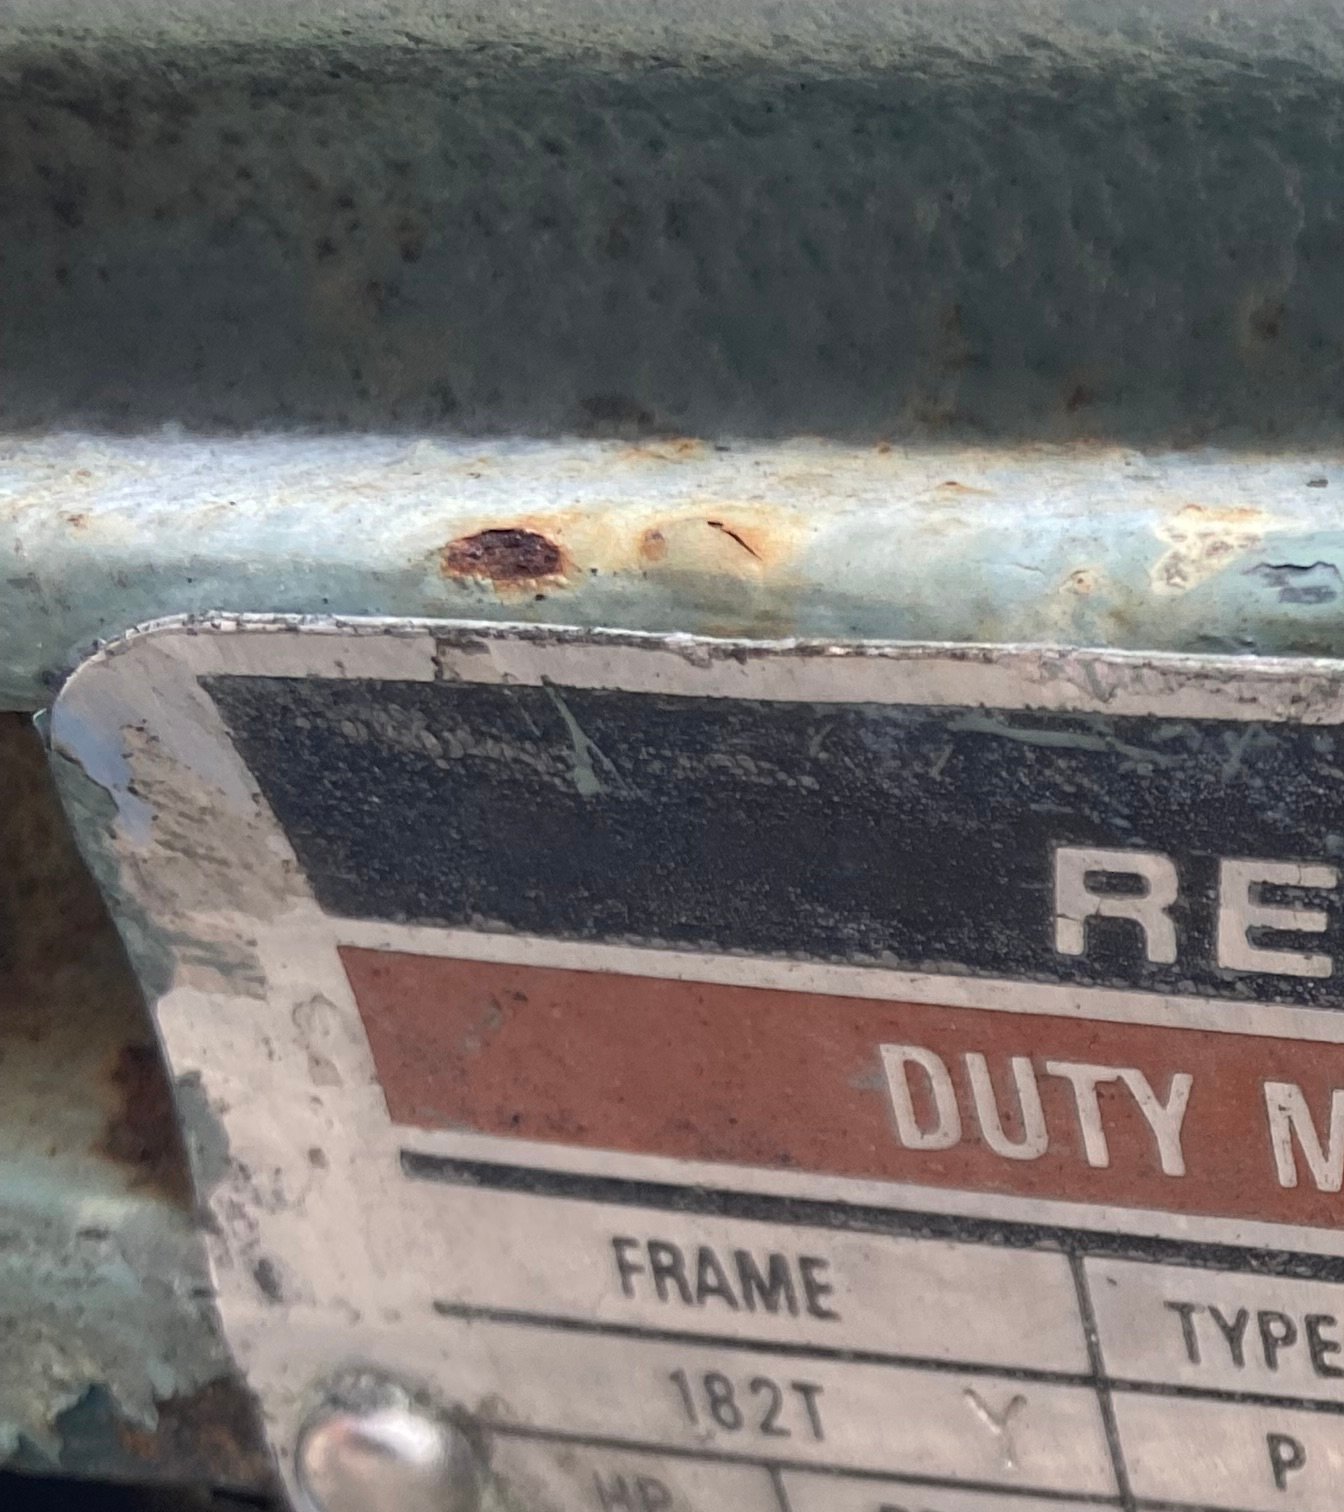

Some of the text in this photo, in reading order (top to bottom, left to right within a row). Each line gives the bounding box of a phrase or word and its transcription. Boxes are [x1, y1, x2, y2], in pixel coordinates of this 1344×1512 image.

[877, 1041, 1193, 1177] DUTY
[611, 1233, 842, 1323] FRAME
[669, 1366, 827, 1442] 182T
[1264, 1431, 1308, 1492] P
